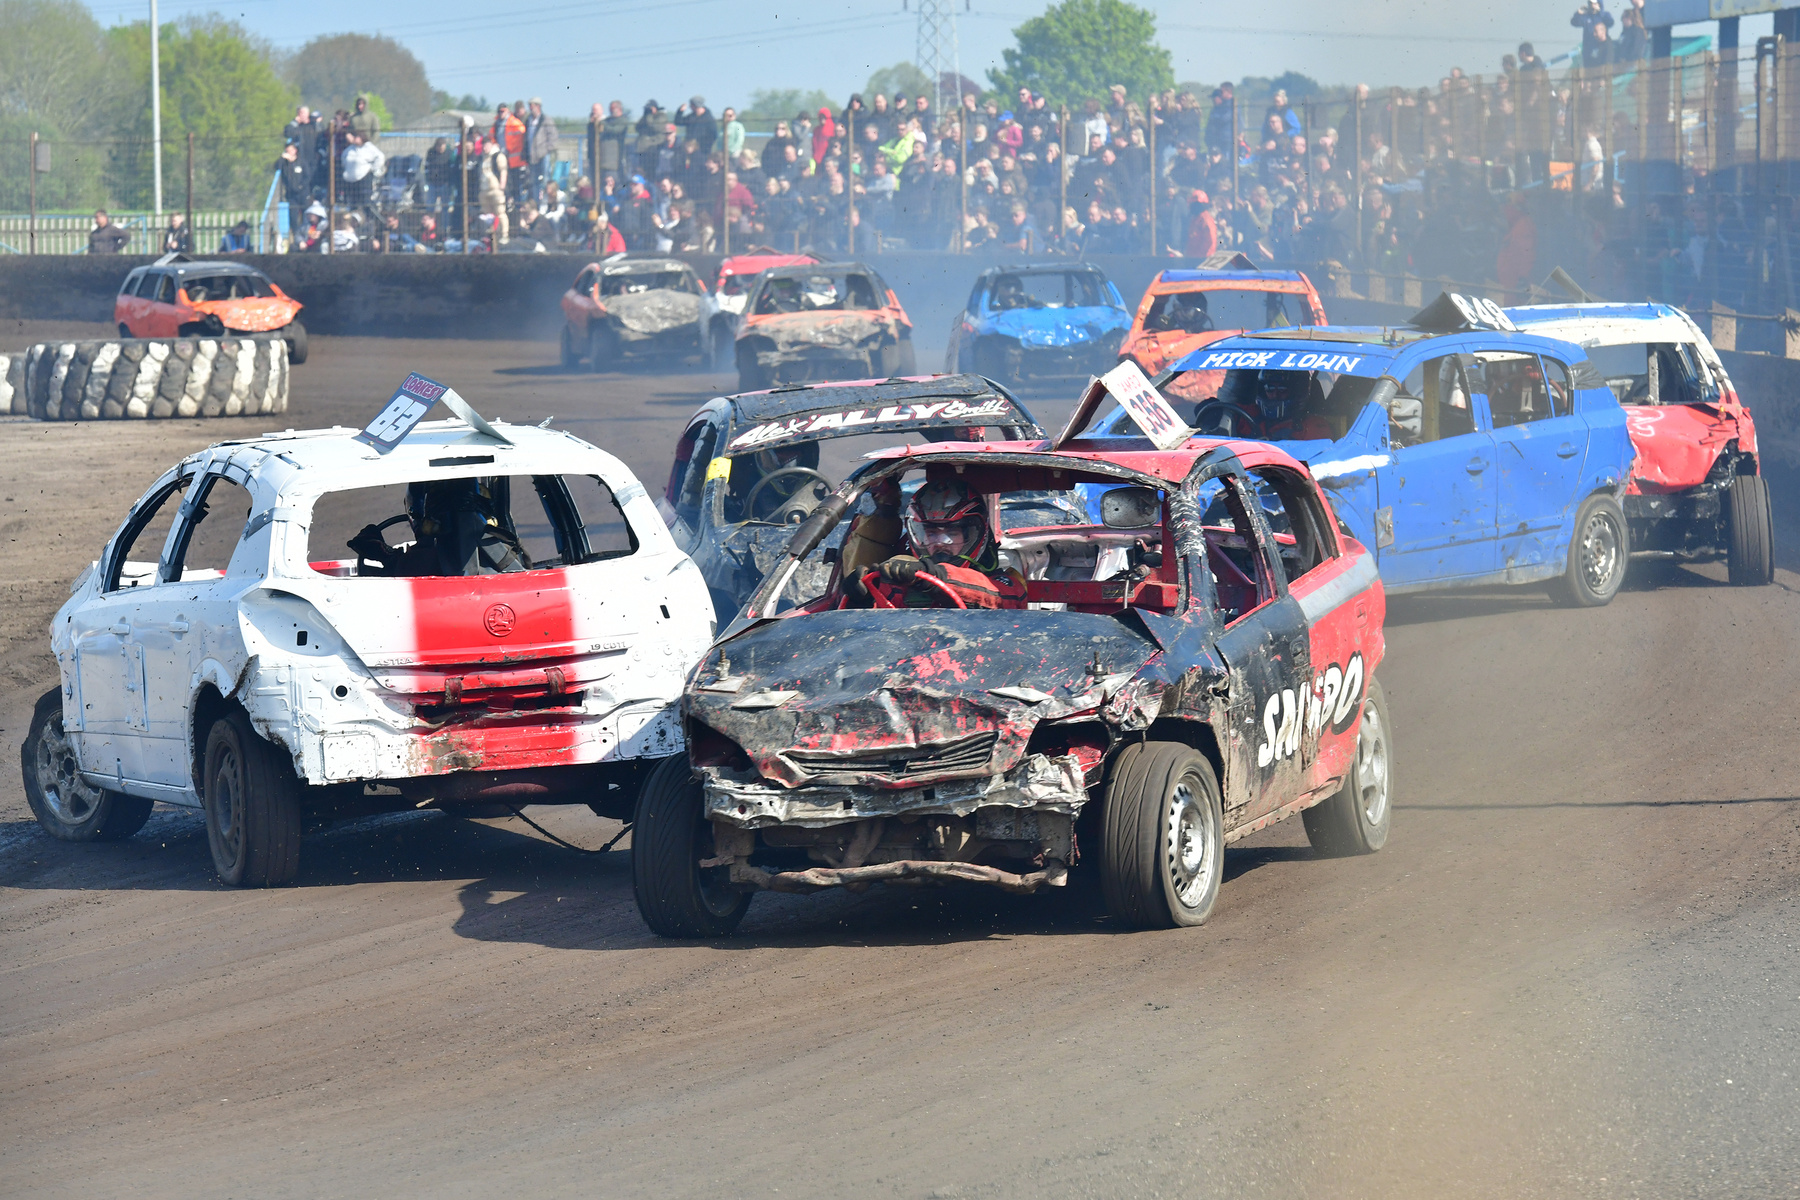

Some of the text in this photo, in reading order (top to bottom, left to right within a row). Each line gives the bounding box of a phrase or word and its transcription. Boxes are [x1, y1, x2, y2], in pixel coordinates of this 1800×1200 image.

[1199, 351, 1361, 372] MICK LOWN
[402, 374, 445, 402] LOAKESY
[365, 393, 428, 443] 83
[729, 417, 809, 448] Alex
[940, 399, 1010, 419] Smith
[1129, 389, 1175, 436] 356
[374, 656, 414, 667] ASTRA
